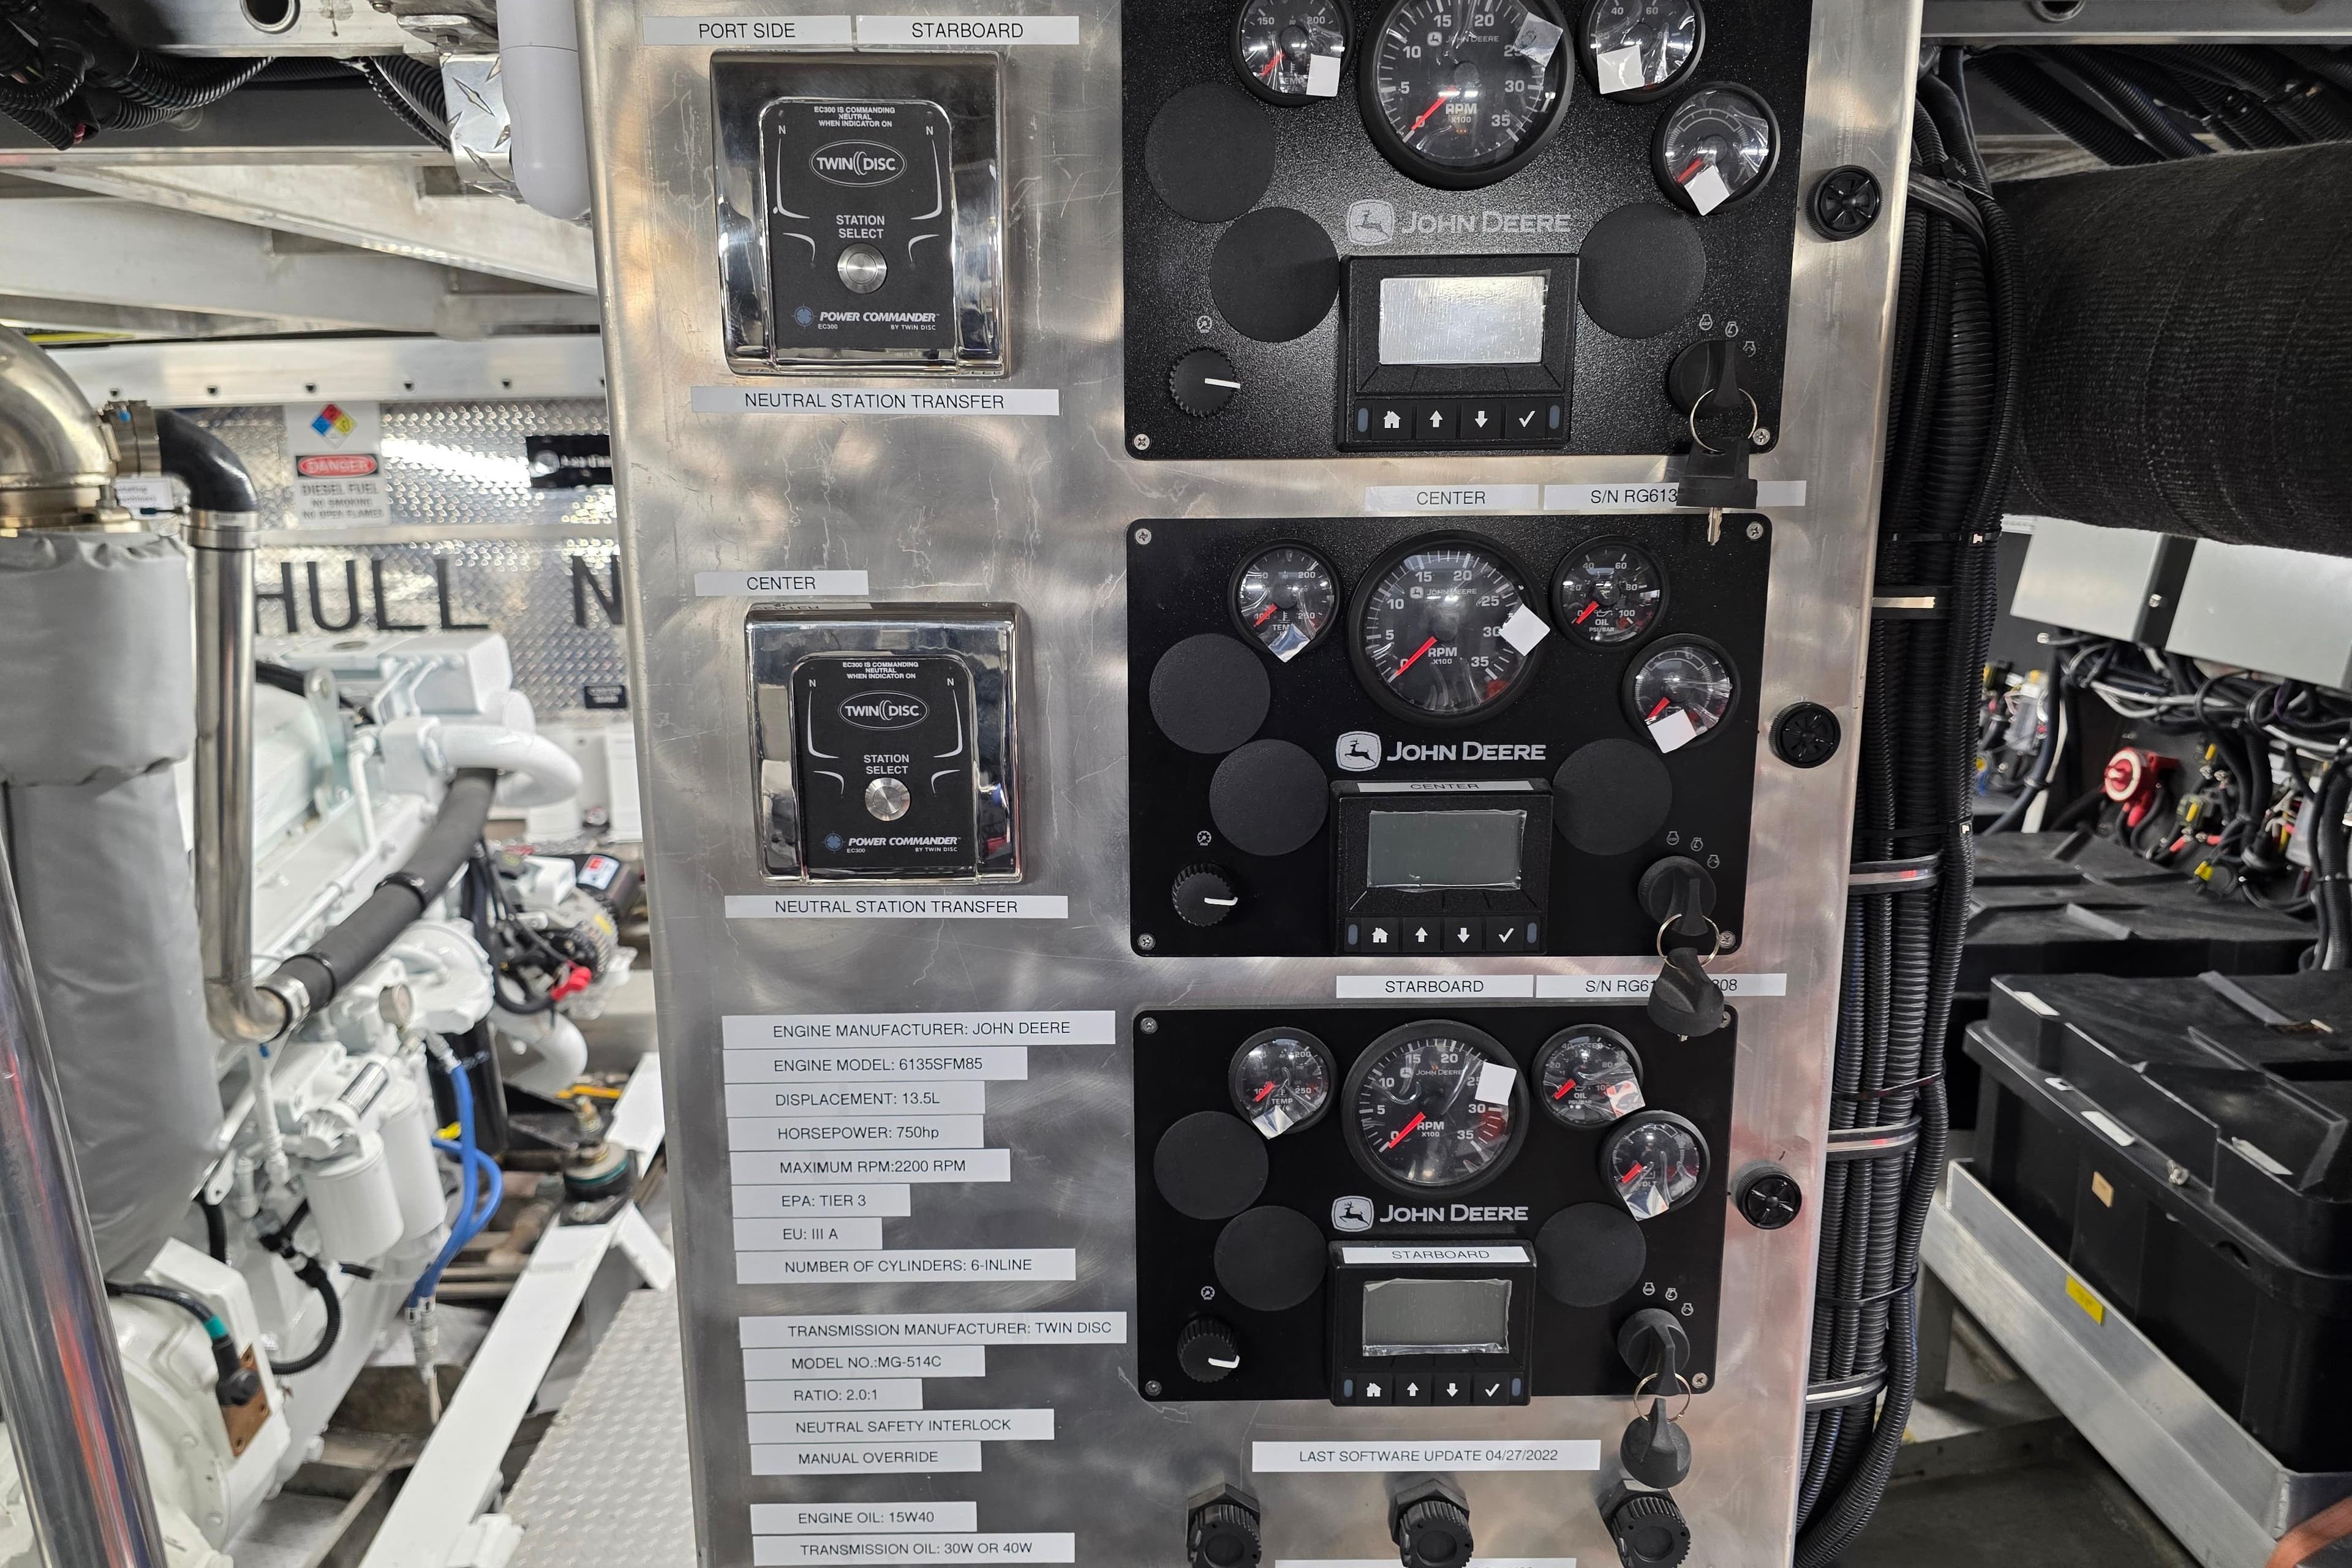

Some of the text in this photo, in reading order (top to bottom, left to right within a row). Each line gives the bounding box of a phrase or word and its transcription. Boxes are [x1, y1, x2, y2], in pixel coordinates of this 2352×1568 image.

[1434, 15, 1451, 27] 15
[1474, 15, 1494, 26] 20
[699, 23, 795, 38] PORT SIDE
[913, 23, 1023, 38] STARBOARD
[1403, 45, 1421, 58] 10
[1505, 80, 1525, 92] 30
[1446, 103, 1477, 114] RPM
[1491, 115, 1510, 126] 35
[778, 126, 786, 135] N
[926, 126, 933, 135] N
[816, 157, 896, 171] TWIN DISC
[836, 216, 885, 225] STATION
[1401, 214, 1570, 235] JOHN DEERE
[839, 228, 884, 239] SELECT
[820, 312, 859, 322] POWER
[745, 393, 1003, 409] NEUTRAL STATION TRANSFER
[309, 460, 368, 472] DANGER
[302, 484, 379, 495] DIESEL FUEL
[1417, 491, 1485, 505] CENTER
[1591, 490, 1618, 503] S/N
[1415, 571, 1432, 582] 15
[1453, 571, 1472, 581] 20
[747, 577, 815, 590] CENTER
[255, 559, 489, 633] HULL
[1387, 599, 1404, 609] 10
[1385, 630, 1395, 640] 5
[1428, 647, 1458, 657] RPM
[1471, 657, 1489, 667] 35
[845, 706, 919, 716] TWIN DISC
[1387, 741, 1546, 761] JOHN DEERE
[863, 753, 910, 763] STATION
[865, 765, 908, 775] SELECT
[848, 837, 886, 846] POWER
[776, 901, 1017, 913] NEUTRAL STATION TRANSFER
[1385, 981, 1483, 992] STARBOARD
[1586, 981, 1611, 992] S/N
[774, 1022, 1070, 1037] ENGINE MANUFACTURER: JOHN DEERE
[775, 1058, 982, 1071] ENGINE MODEL: 6135SFM85
[1408, 1054, 1421, 1064] 15
[776, 1093, 940, 1106] DISPLACEMENT: 13.5L
[778, 1126, 938, 1139] HORSEPOWER: 750hp
[780, 1160, 965, 1173] MAXIMUM RPM:2200 RPM
[782, 1195, 866, 1207] EPA: TIER 3
[1381, 1204, 1528, 1223] JOHN DEERE
[783, 1229, 838, 1240] EU: III A
[785, 1259, 1031, 1272] NUMBER OF CYLINDERS: 6-INLINE
[788, 1322, 1111, 1336] TRANSMISSION MANUFACTURER: TWIN DISC
[793, 1356, 941, 1369] MODEL NO.:MG-514C
[794, 1389, 876, 1401] RATIO: 2.0:1
[796, 1420, 1011, 1433] NEUTRAL SAFETY INTERLOCK
[799, 1452, 938, 1464] MANUAL OVERRIDE
[1300, 1450, 1558, 1461] LAST SOFTWARE UPDATE 04/27/2022
[799, 1512, 933, 1523] ENGINE OIL: 15W40
[800, 1543, 1032, 1555] TRANSMISSION OIL: 30W OR 40W
